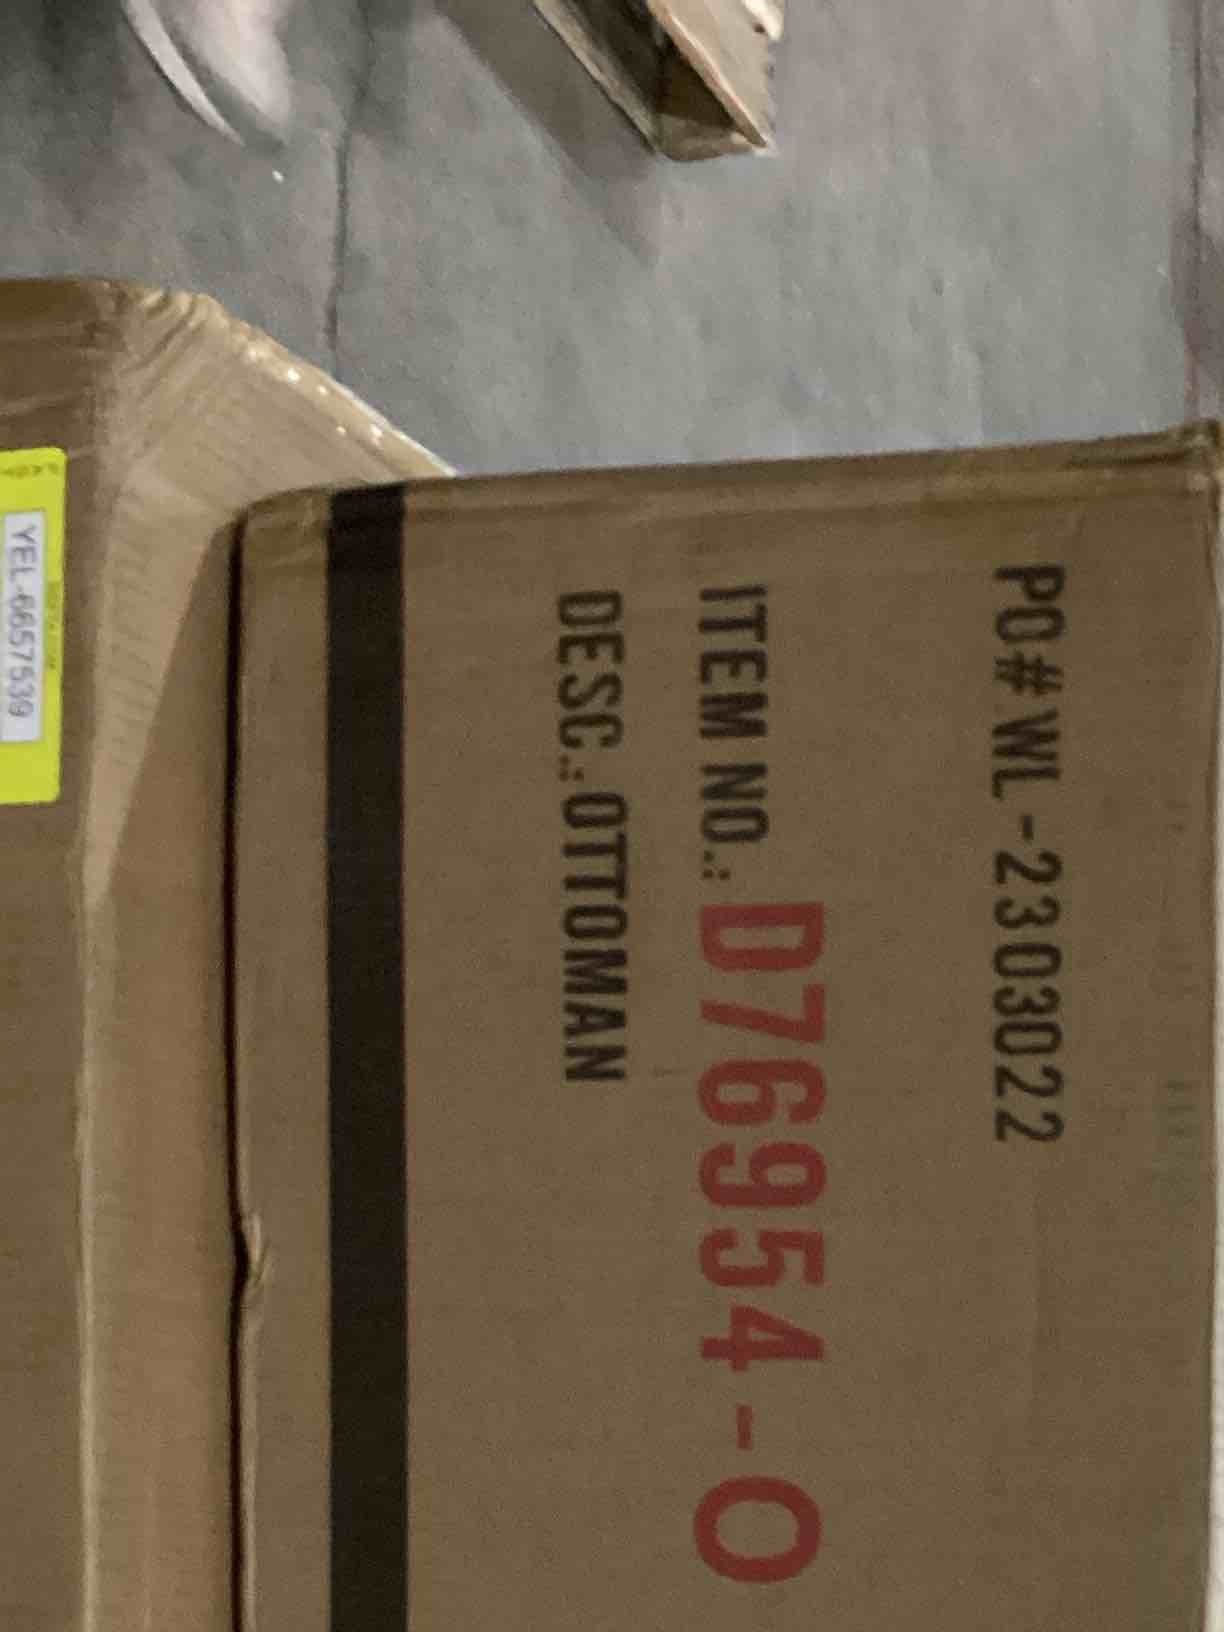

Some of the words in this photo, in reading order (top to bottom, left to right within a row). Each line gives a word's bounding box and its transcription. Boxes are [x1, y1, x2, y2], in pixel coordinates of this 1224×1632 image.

[697, 583, 768, 740] ITEM
[993, 563, 1066, 695] PO#
[699, 761, 771, 882] NO.:
